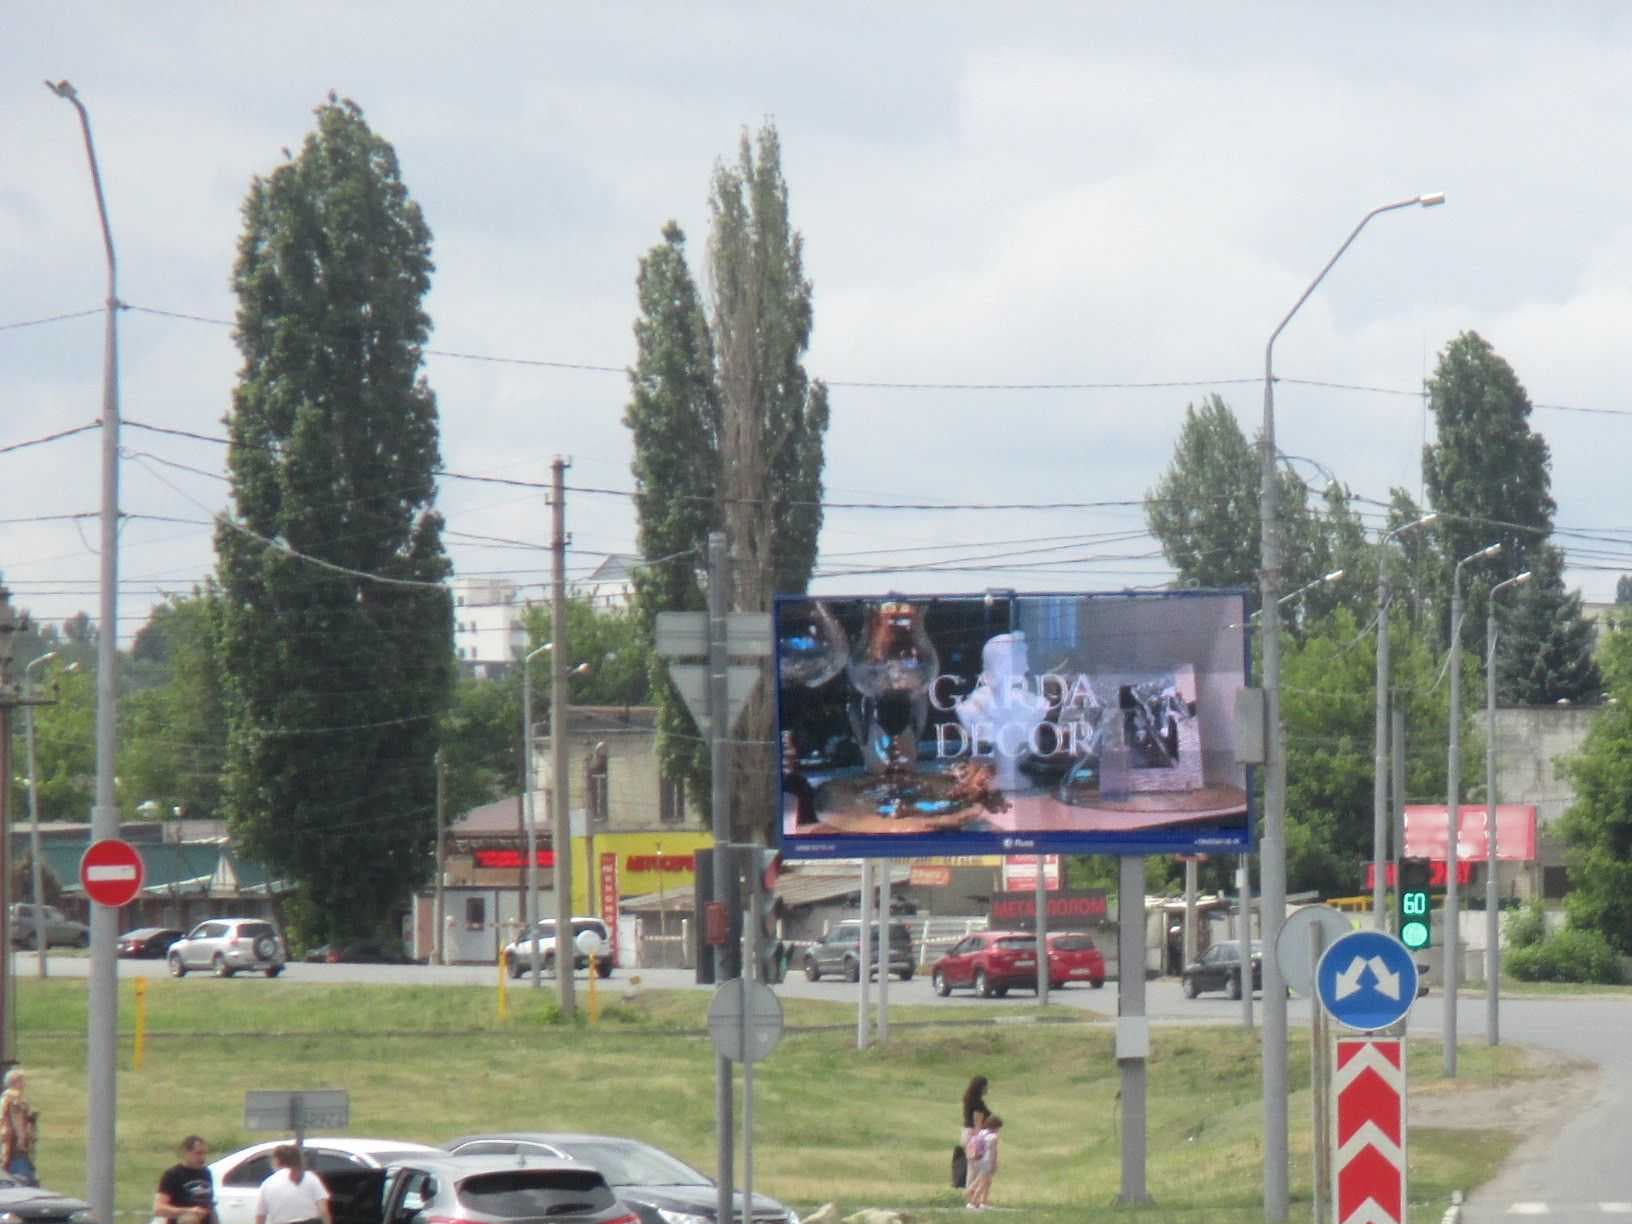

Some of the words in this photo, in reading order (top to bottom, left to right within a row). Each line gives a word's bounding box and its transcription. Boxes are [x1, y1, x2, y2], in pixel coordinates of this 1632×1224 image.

[928, 672, 1101, 712] GARDA
[935, 720, 1096, 758] DECOR
[992, 897, 1105, 918] МЕТАЛОЛОМ
[1403, 892, 1426, 914] 60
